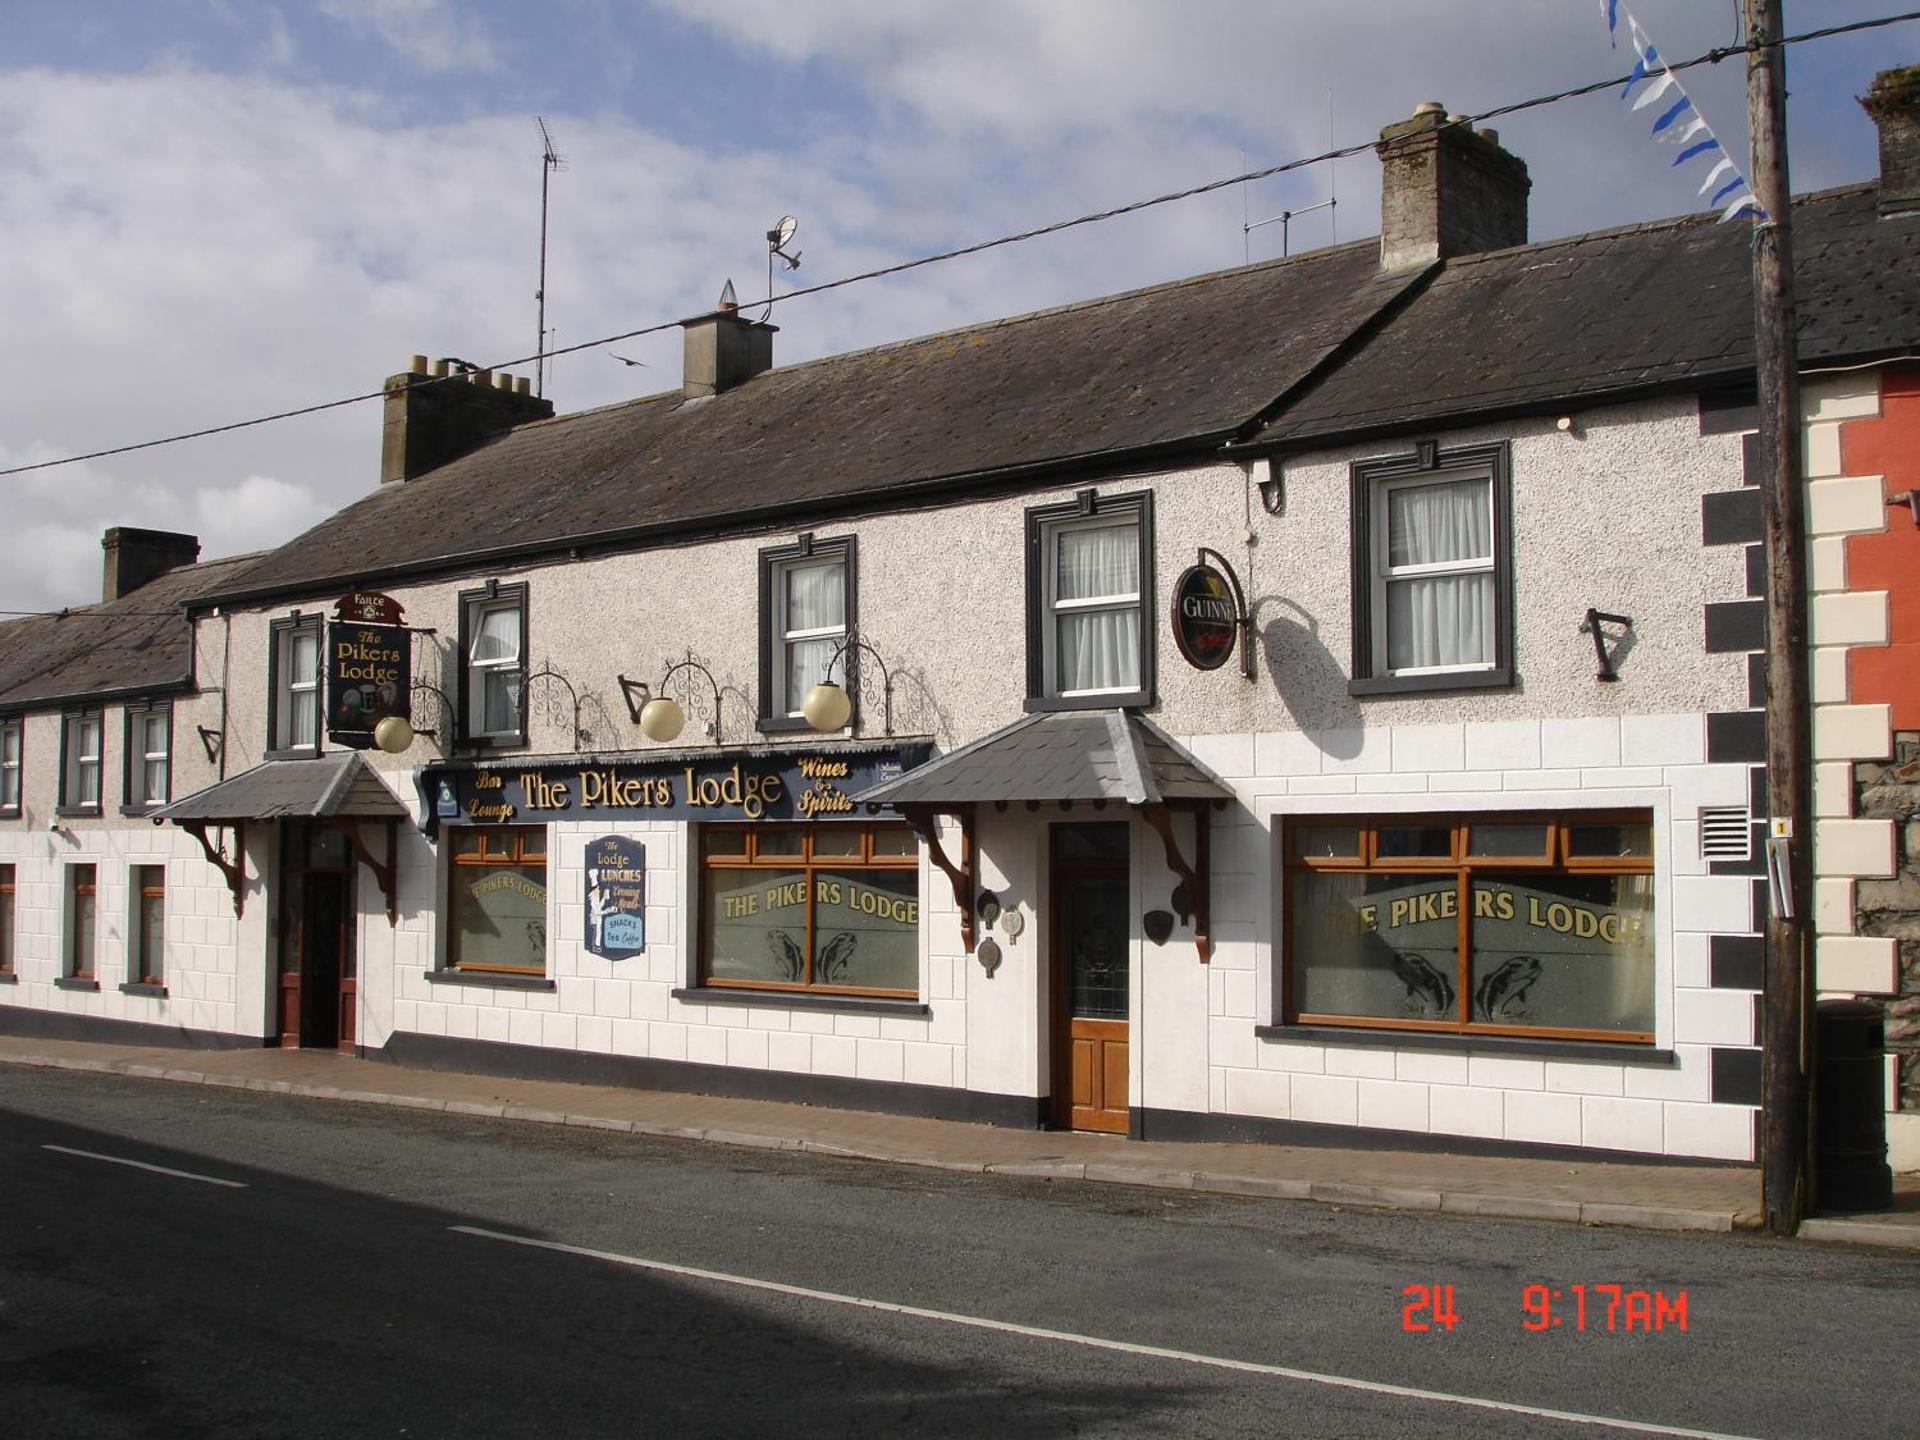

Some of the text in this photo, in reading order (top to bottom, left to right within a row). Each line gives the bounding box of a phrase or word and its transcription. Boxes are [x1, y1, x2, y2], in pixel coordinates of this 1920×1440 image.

[357, 631, 382, 644] The
[337, 643, 400, 663] Pikers
[340, 662, 399, 686] Lodge
[797, 756, 848, 778] Wines
[475, 770, 502, 789] Bar
[520, 762, 781, 819] The Pikers Lodge
[815, 778, 831, 792] &
[467, 798, 513, 823] Lounge
[797, 789, 854, 819] Spirits
[597, 853, 630, 868] Lodge
[601, 869, 641, 882] LUNCHES
[723, 881, 919, 924] THE PIKERS LODGE
[1389, 888, 1514, 928] PIKERS
